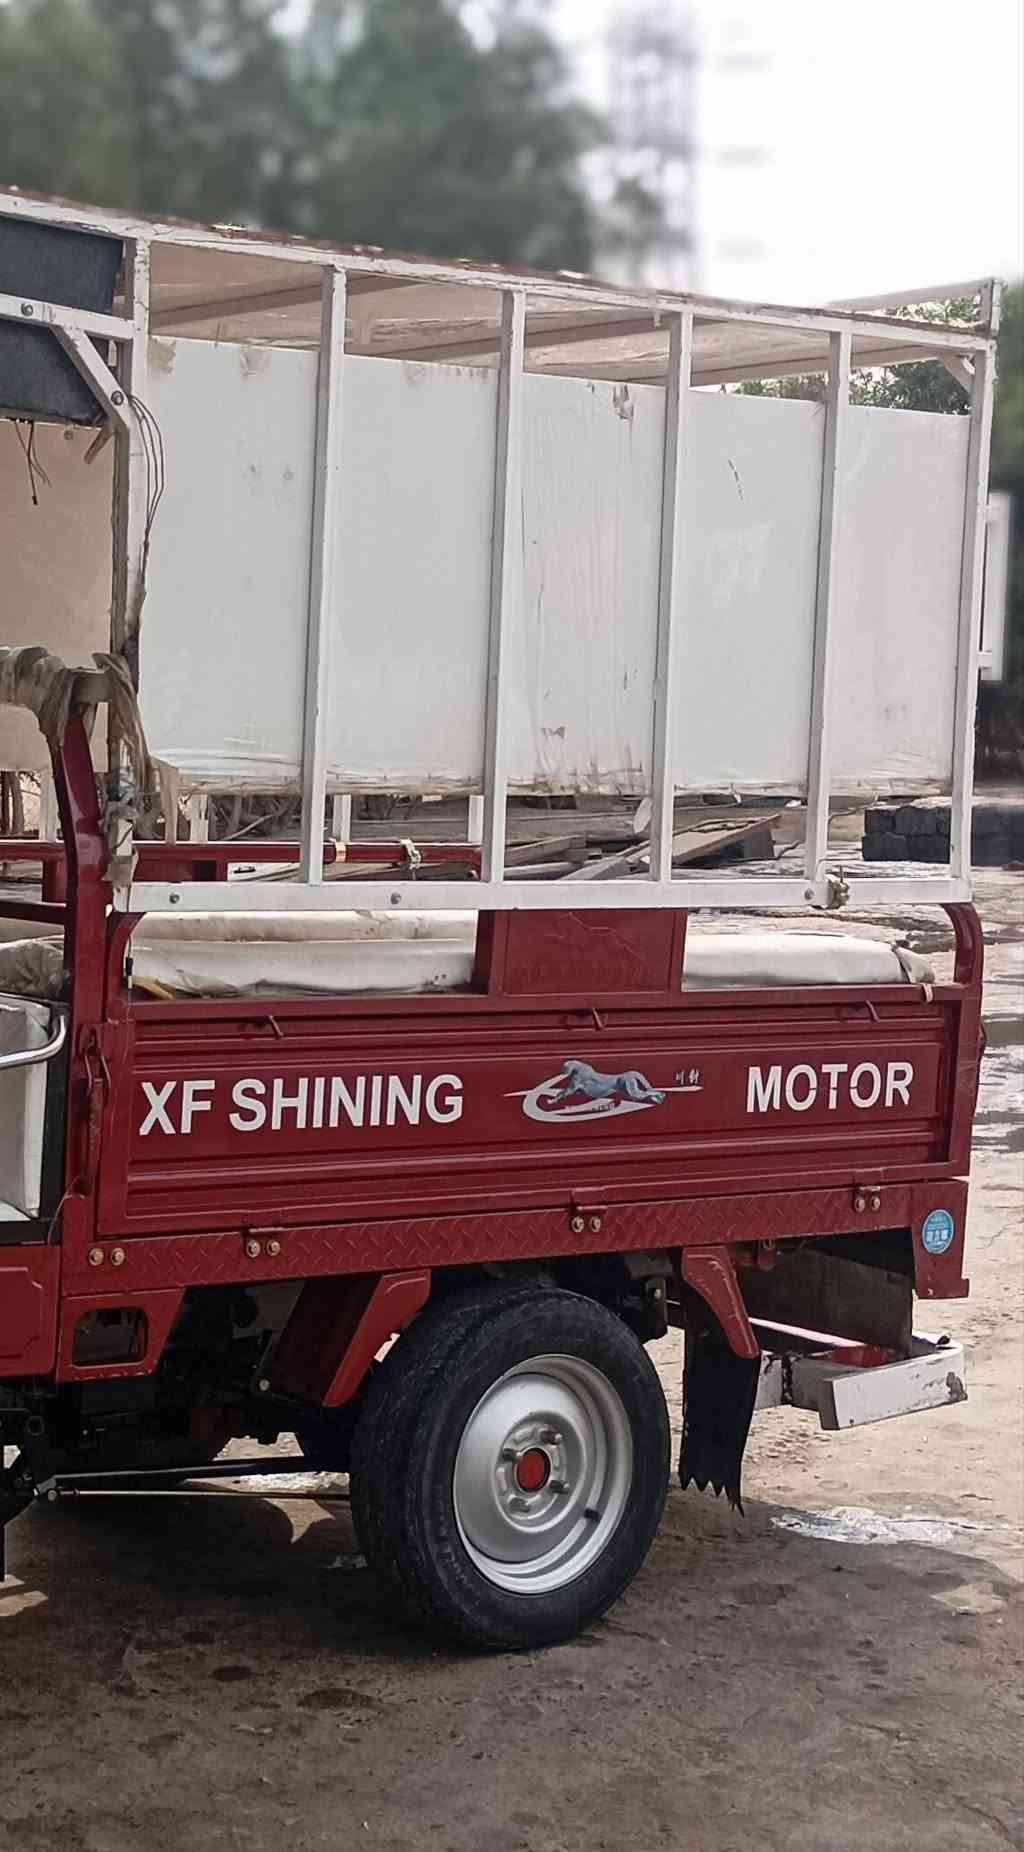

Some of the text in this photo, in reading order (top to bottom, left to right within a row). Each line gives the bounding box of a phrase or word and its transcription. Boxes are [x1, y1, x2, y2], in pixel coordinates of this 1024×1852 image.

[140, 1074, 463, 1135] XF SHINING
[747, 1062, 914, 1112] MOTOR
